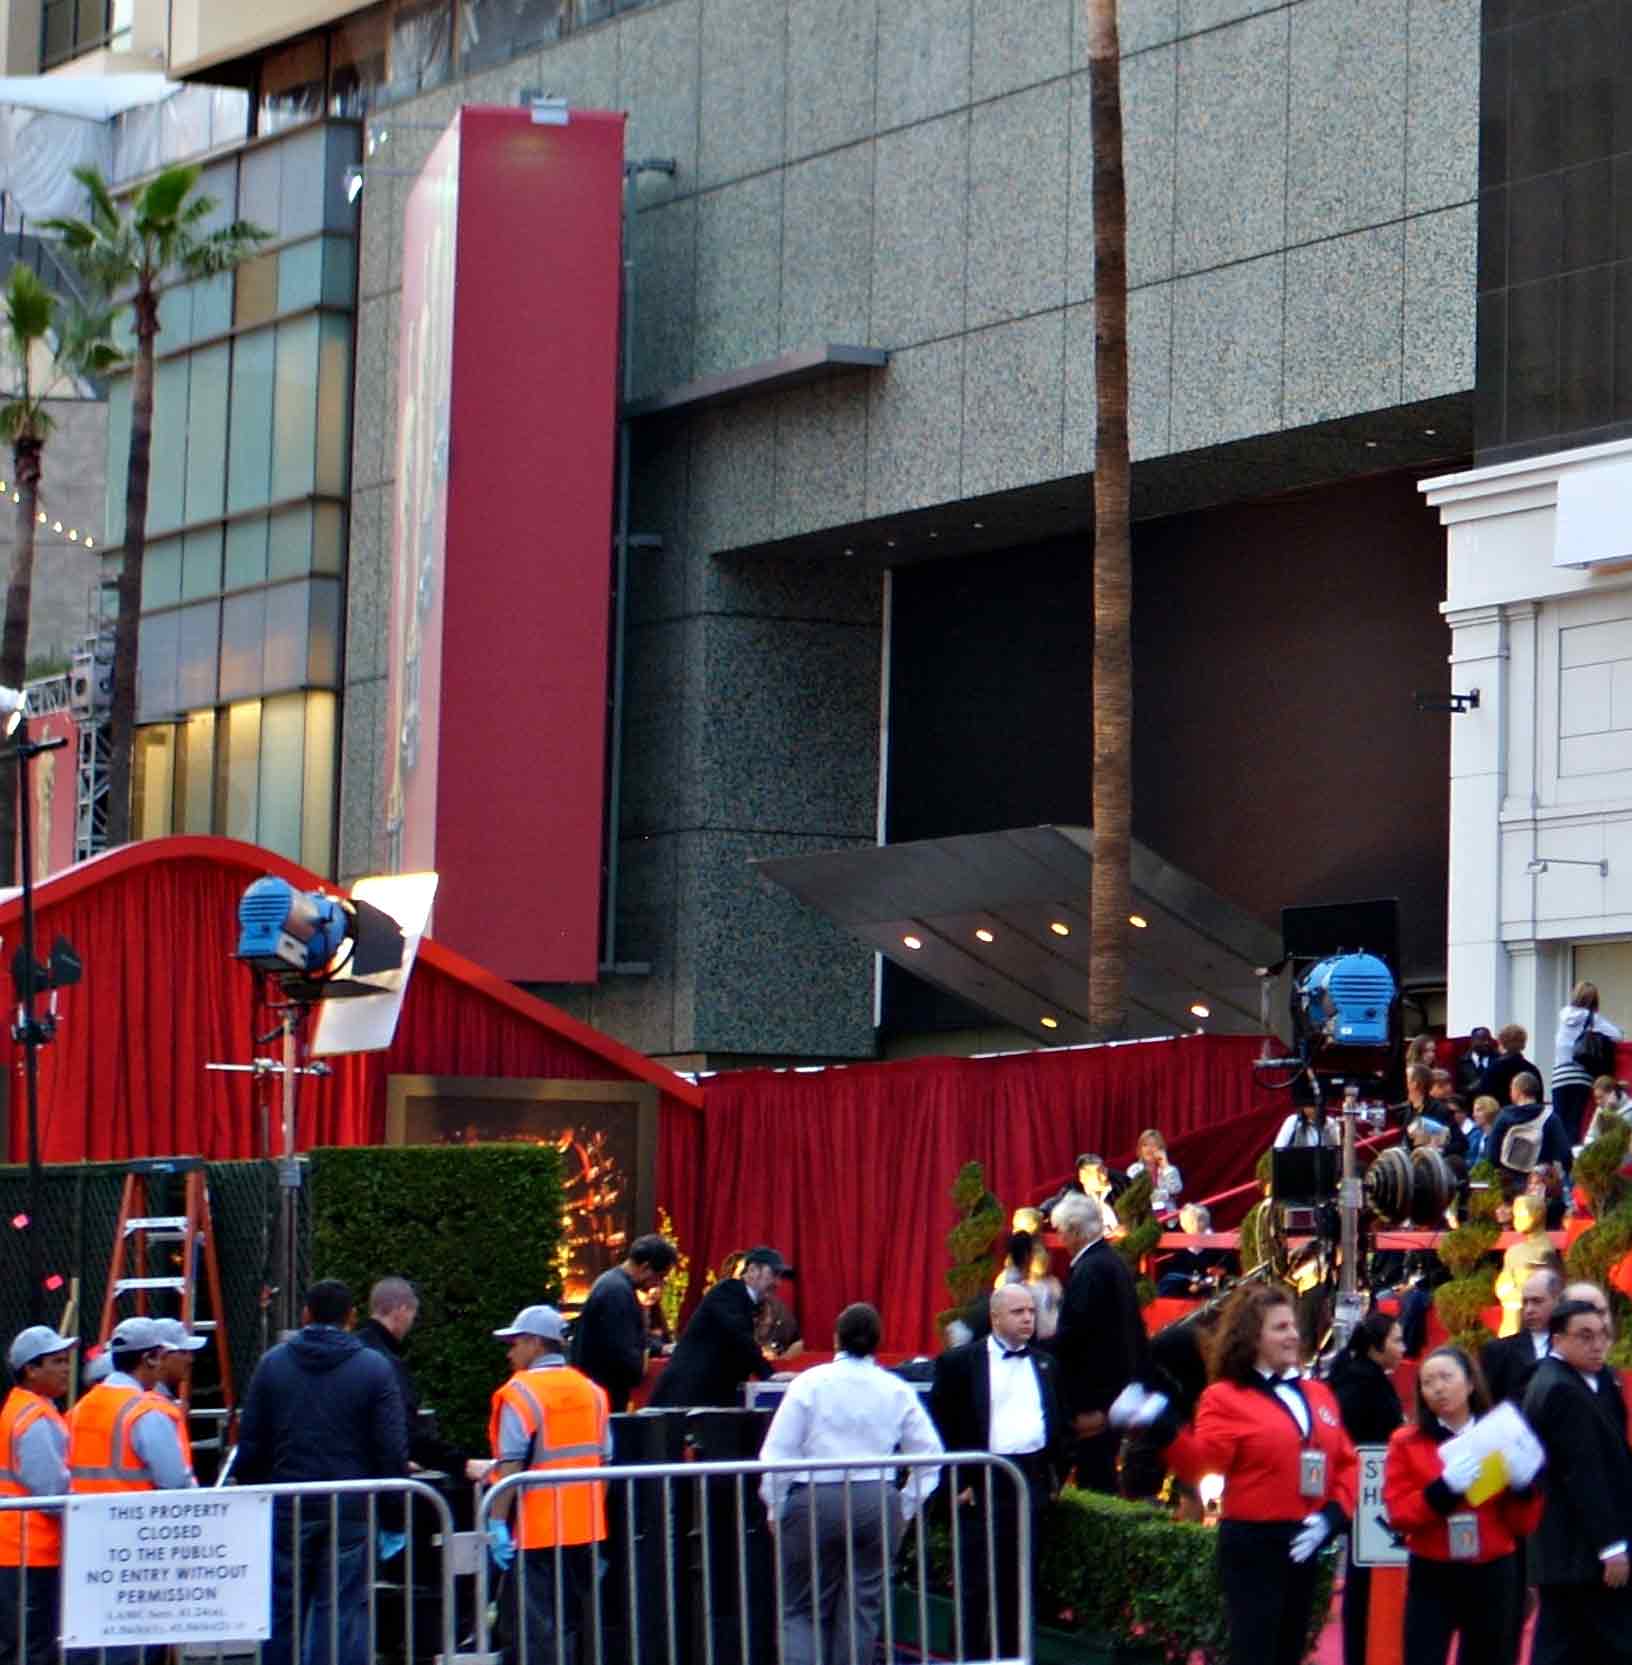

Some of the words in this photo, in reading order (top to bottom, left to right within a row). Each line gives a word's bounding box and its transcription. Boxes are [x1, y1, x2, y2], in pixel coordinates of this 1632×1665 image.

[109, 1506, 144, 1520] THIS
[150, 1503, 231, 1519] PROPERTY
[137, 1525, 203, 1541] CLOSED
[109, 1548, 131, 1562] TO
[137, 1547, 165, 1561] THE
[171, 1544, 228, 1560] PUBLIC
[86, 1569, 113, 1584] NO
[121, 1567, 170, 1583] ENTRY
[175, 1564, 248, 1581] WITHOUT
[116, 1587, 217, 1604] PERMISSION
